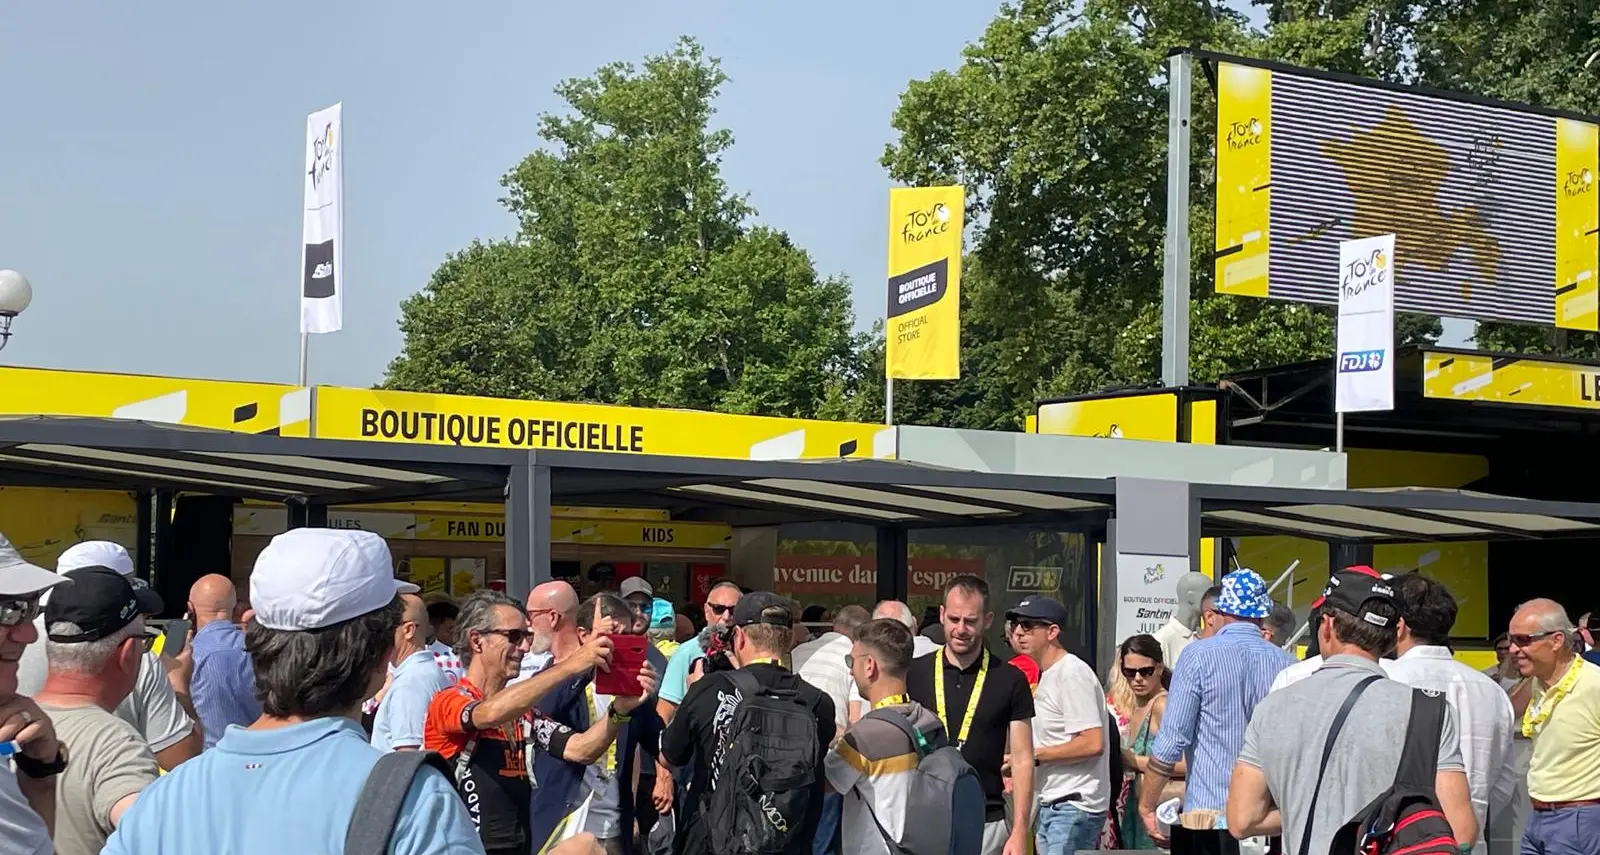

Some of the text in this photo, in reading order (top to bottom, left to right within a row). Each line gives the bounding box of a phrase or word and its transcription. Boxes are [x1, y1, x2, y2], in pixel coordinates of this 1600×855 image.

[898, 272, 937, 294] BOUTIQUE
[898, 282, 938, 305] OFFICIELLE
[898, 315, 928, 333] OFFICIAL
[897, 328, 921, 344] STORE
[1340, 354, 1367, 371] FDJ
[361, 408, 644, 452] BOUTIQUE OFFICIELLE
[447, 521, 505, 537] FAN DU
[642, 527, 674, 543] KIDS
[1011, 571, 1041, 587] FDJ
[1123, 596, 1153, 604] BOUTIQUE
[1136, 608, 1173, 620] Santini
[462, 767, 481, 834] ZADOR
